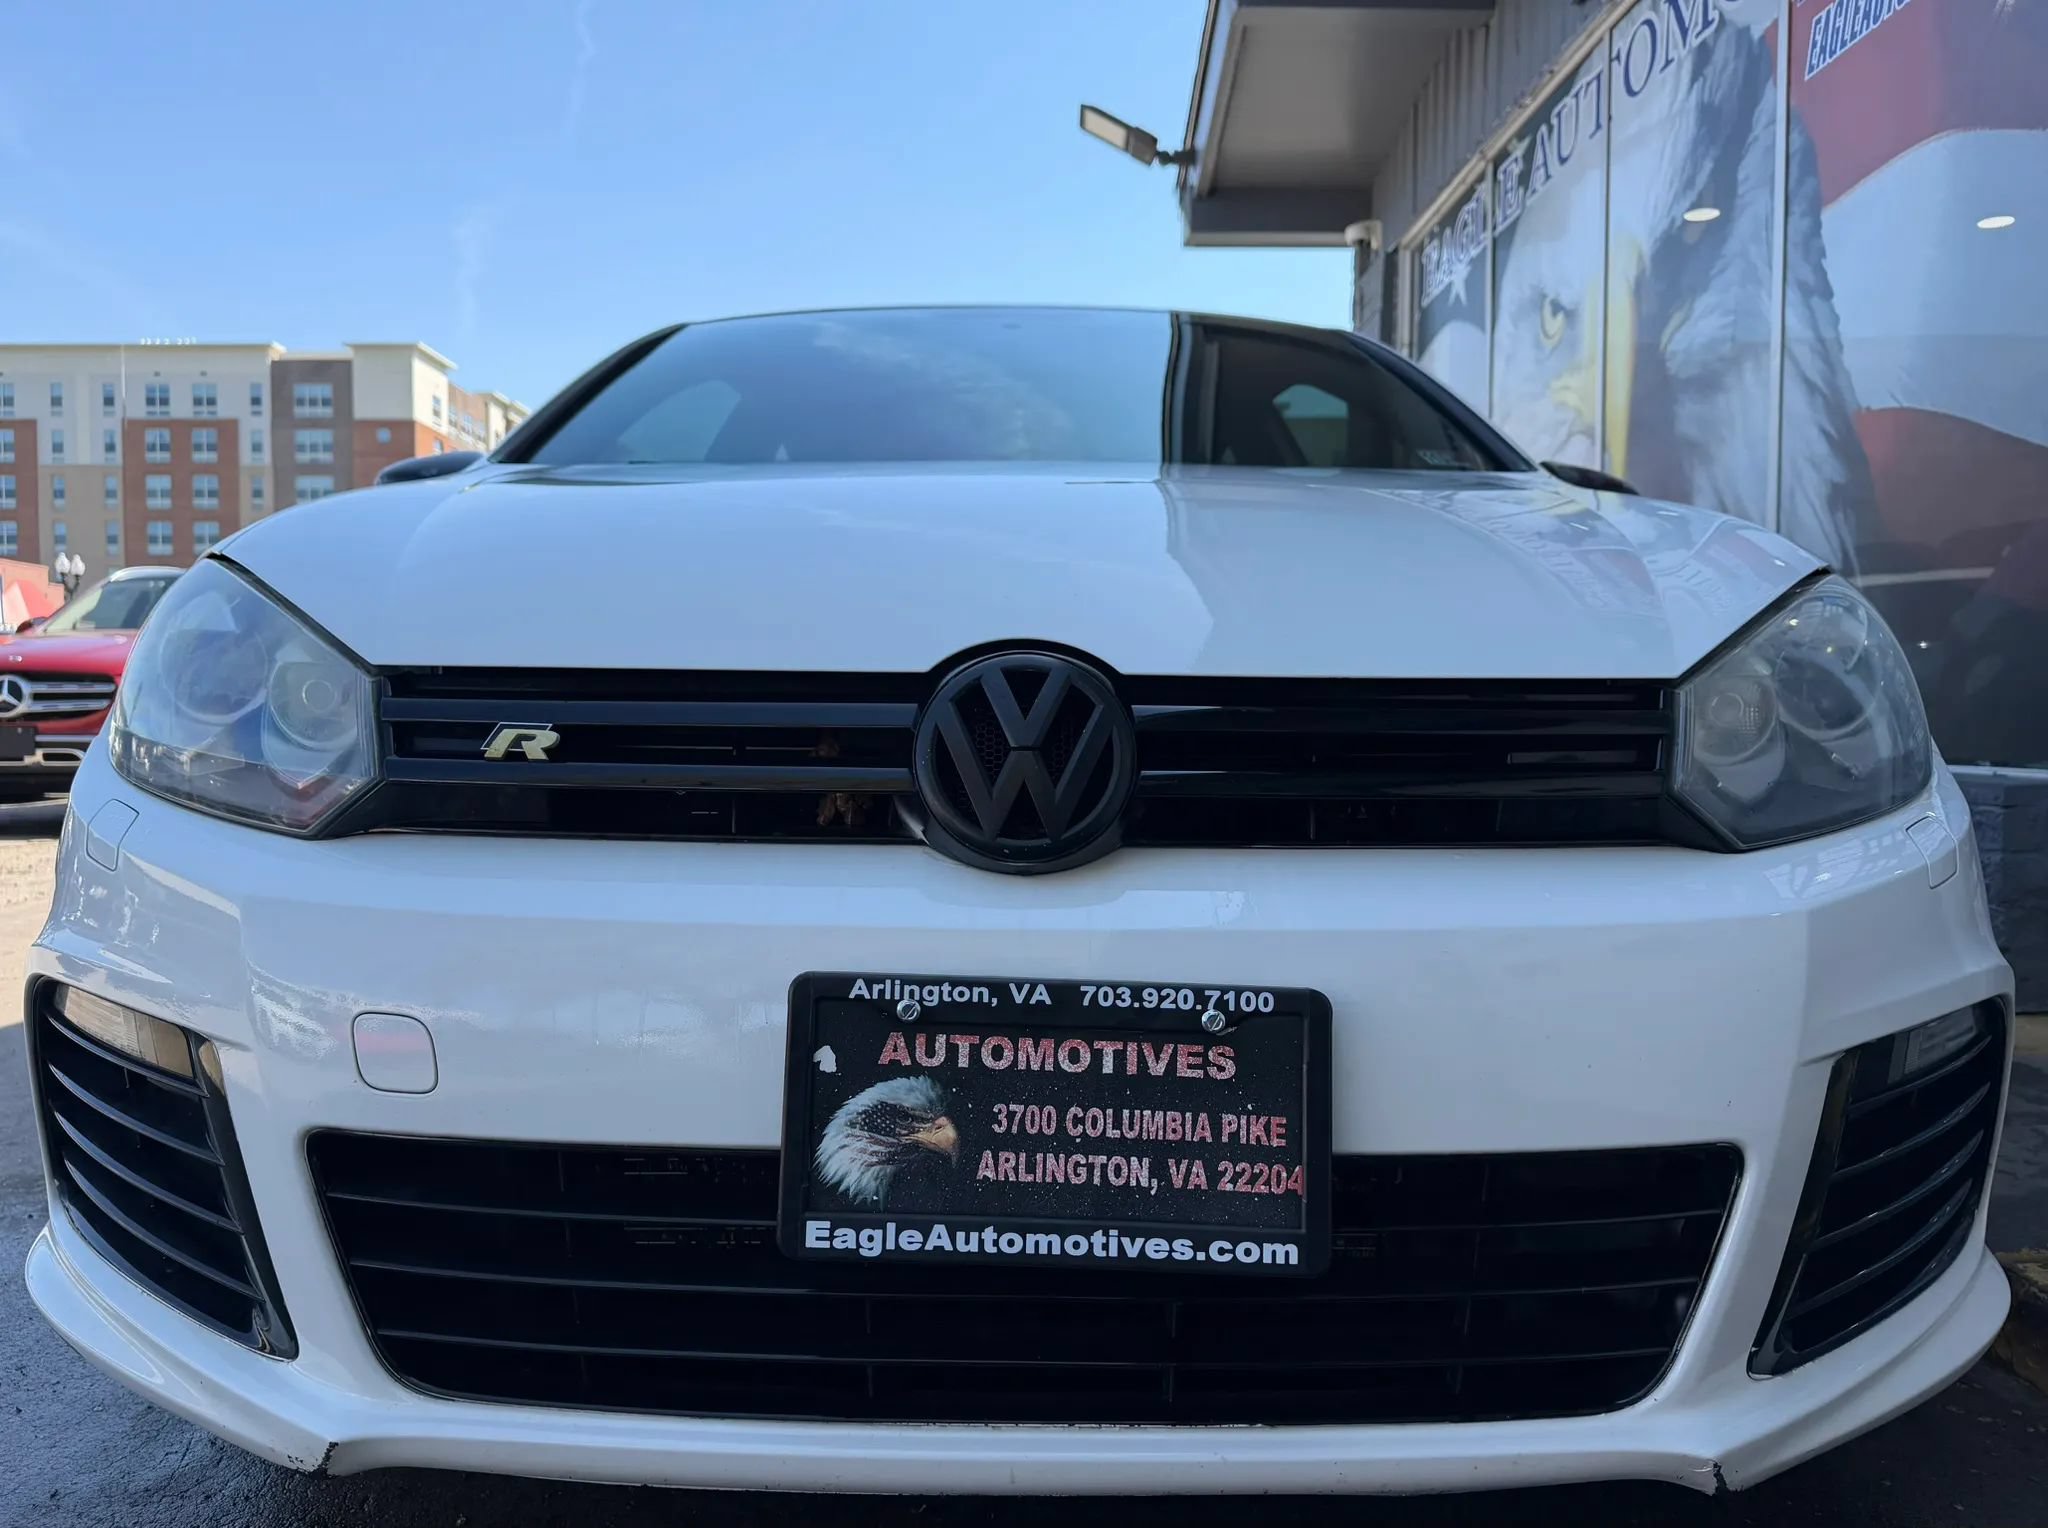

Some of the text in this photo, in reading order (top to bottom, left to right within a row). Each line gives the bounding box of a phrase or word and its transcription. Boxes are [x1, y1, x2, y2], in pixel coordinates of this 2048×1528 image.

[1525, 0, 1745, 205] AUTOM
[483, 728, 560, 760] R
[848, 978, 1275, 1014] Arlington, VA 703.920.7100
[878, 1031, 1237, 1081] AUTOMOTIVES
[990, 1103, 1288, 1148] 3700 COLUMBIA PIKE
[975, 1150, 1304, 1196] ARLINGTON, VA 22204
[804, 1219, 1301, 1265] EagleAutomotives.com
